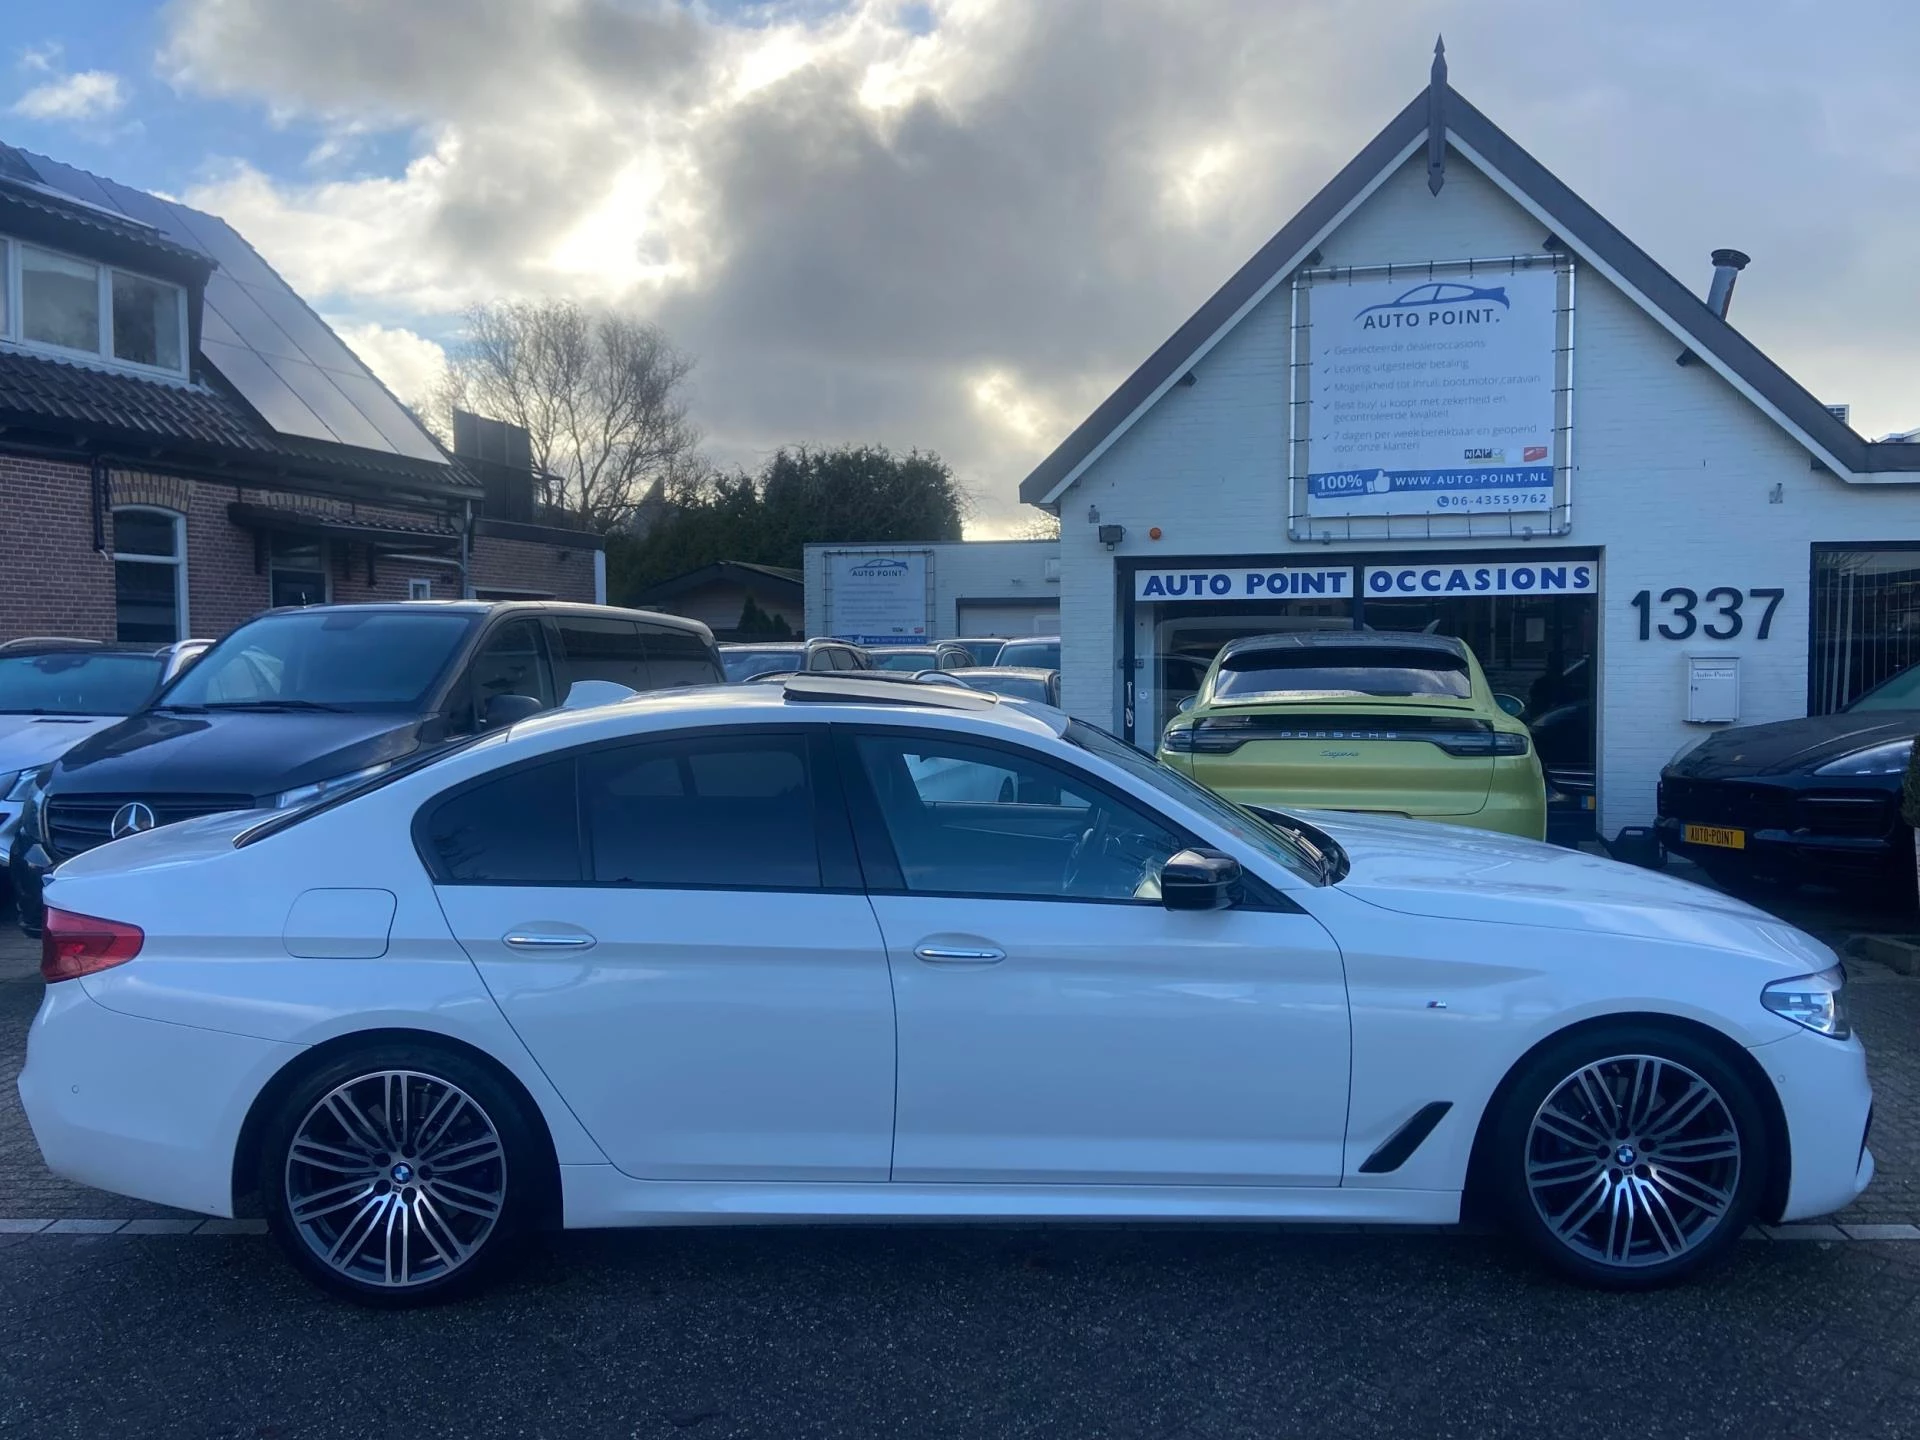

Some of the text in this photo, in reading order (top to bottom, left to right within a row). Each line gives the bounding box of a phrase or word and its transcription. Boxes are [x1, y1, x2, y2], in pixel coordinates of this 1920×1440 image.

[1363, 312, 1420, 330] AUTO
[1429, 359, 1470, 370] betaling
[1333, 431, 1340, 440] 7
[1342, 430, 1372, 442] dagen
[1374, 430, 1391, 441] per
[1318, 474, 1363, 490] 100%
[1452, 493, 1547, 505] 06-43559762
[1143, 571, 1348, 596] AUTO POINT
[1370, 566, 1591, 593] OCCASIONS
[1630, 586, 1785, 640] 1337
[1691, 827, 1735, 846] AUTO-POINT
